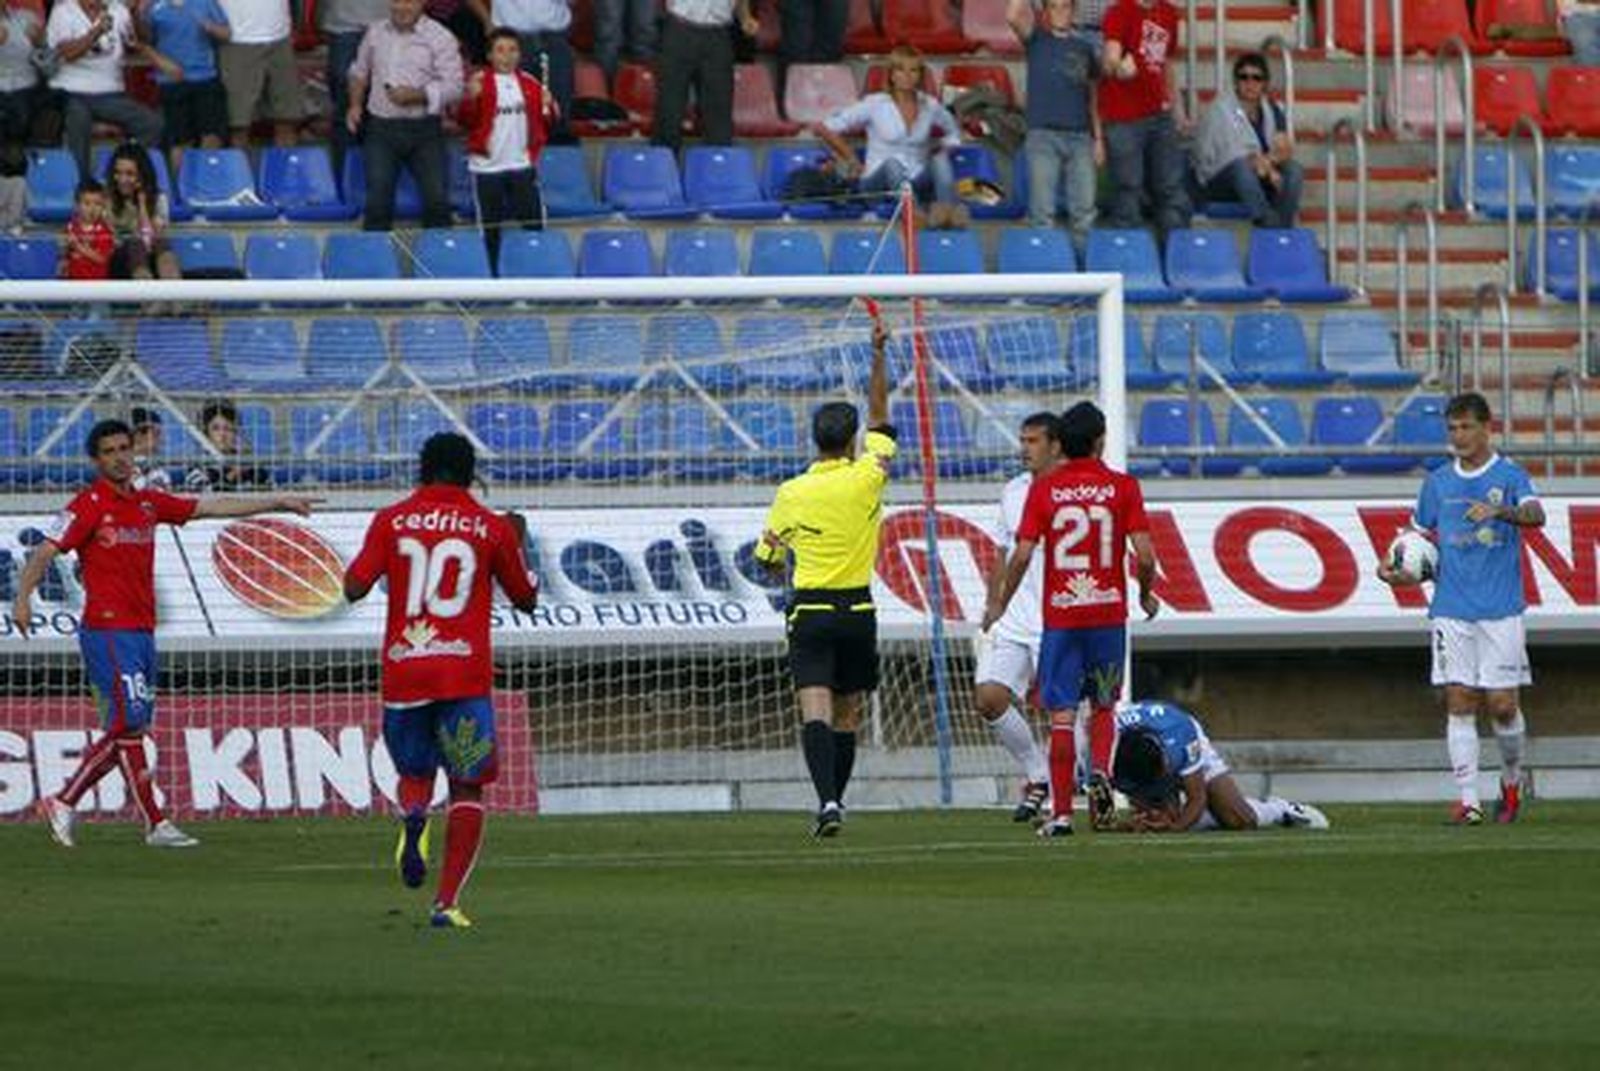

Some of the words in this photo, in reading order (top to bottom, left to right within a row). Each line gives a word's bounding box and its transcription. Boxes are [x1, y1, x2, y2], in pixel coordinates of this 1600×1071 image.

[392, 510, 488, 539] cedrick
[1052, 505, 1114, 570] 21
[398, 537, 477, 618] 10
[598, 601, 748, 625] FUTURO
